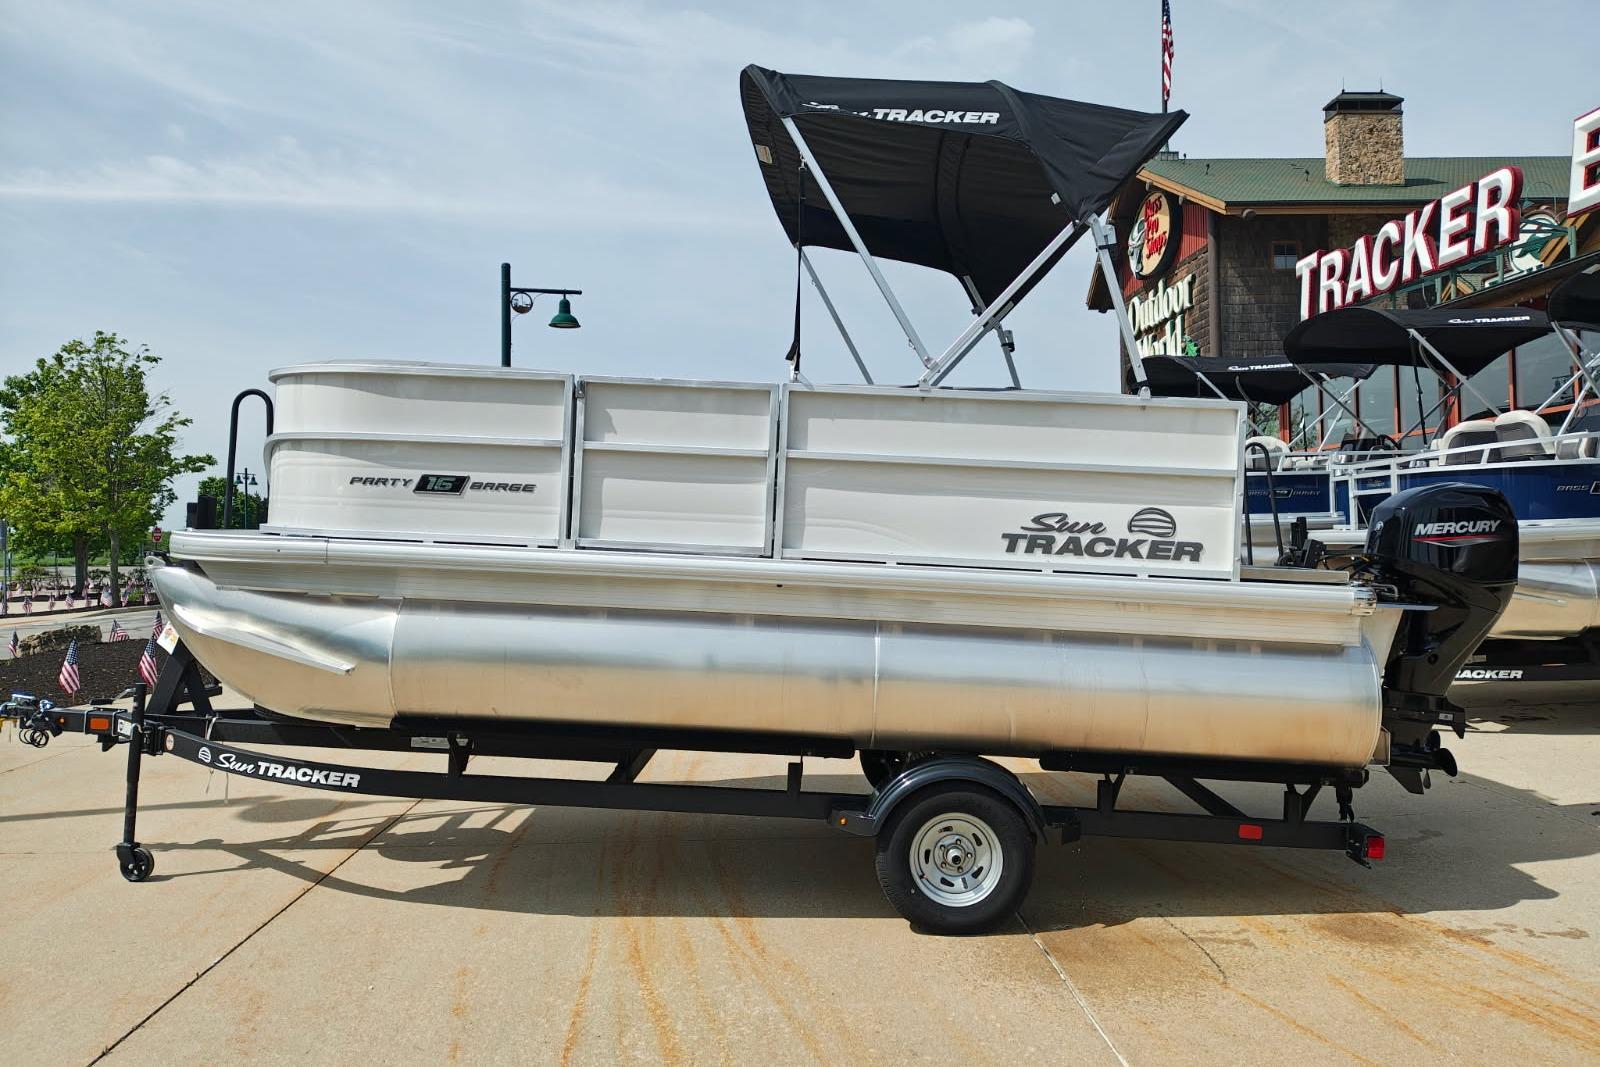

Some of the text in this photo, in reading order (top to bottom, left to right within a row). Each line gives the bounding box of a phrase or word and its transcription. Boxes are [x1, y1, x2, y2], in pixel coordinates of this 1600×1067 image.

[872, 108, 1000, 125] TRACKER
[1295, 165, 1524, 323] TRACKER
[1128, 273, 1194, 336] Outdoor
[1474, 315, 1531, 323] TRACKER
[349, 476, 537, 493] PARTY 16 BARGE
[1020, 512, 1107, 535] Sun
[1414, 520, 1501, 536] MERCURY
[1001, 532, 1204, 562] TRACKER
[214, 753, 361, 788] Sun TRACKER
